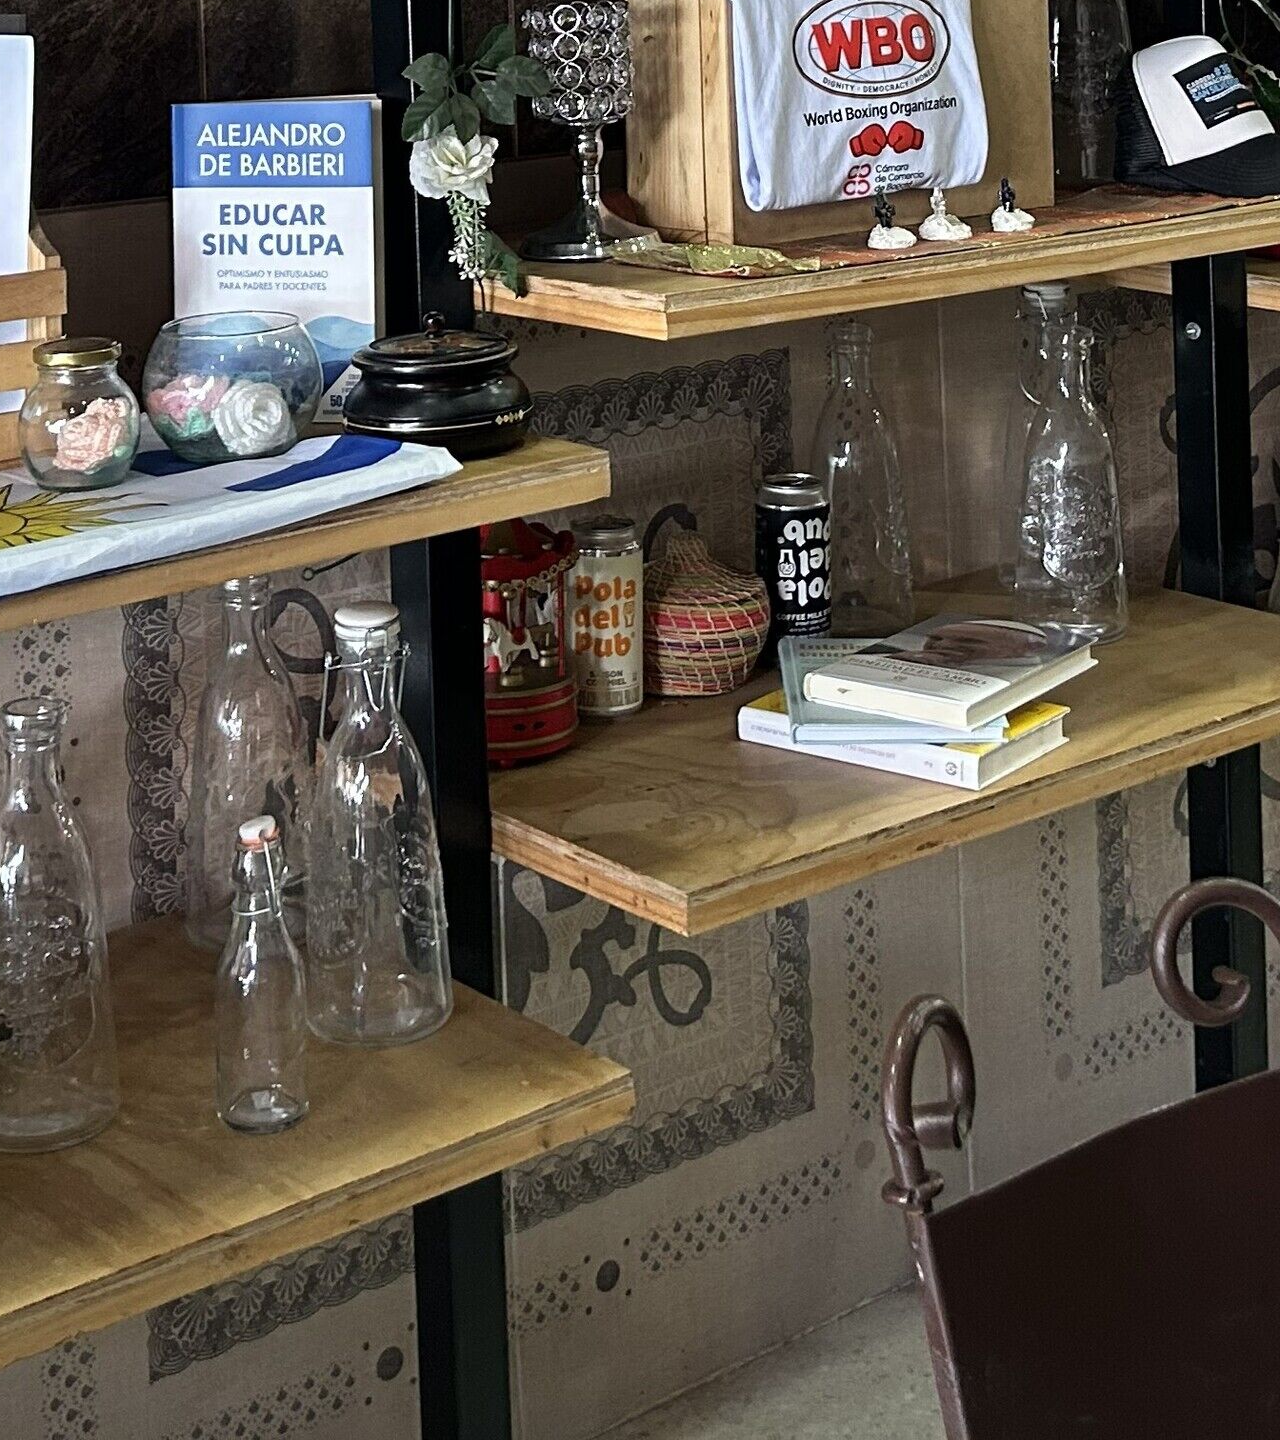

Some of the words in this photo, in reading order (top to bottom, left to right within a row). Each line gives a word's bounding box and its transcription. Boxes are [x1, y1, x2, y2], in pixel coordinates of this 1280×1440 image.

[811, 13, 936, 73] WBO
[822, 76, 856, 92] DIGNITY
[862, 81, 910, 93] DEMOCRACY
[803, 108, 843, 127] World
[844, 103, 888, 120] Boxing
[889, 94, 957, 117] Organization
[196, 122, 346, 147] ALEJANDRO
[199, 153, 231, 177] DE
[239, 152, 345, 177] BARBIERI
[219, 204, 326, 226] EDUCAR
[202, 233, 248, 256] SIN
[258, 233, 345, 256] CULPA
[216, 269, 265, 279] OPTIMISMO
[266, 269, 272, 278] Y
[274, 269, 329, 279] ENTUSIASMO
[219, 281, 242, 291] PARA
[243, 281, 273, 291] PADRES
[274, 281, 280, 290] Y
[282, 281, 327, 291] DOCENTES
[574, 574, 636, 603] Pola
[574, 603, 619, 630] del
